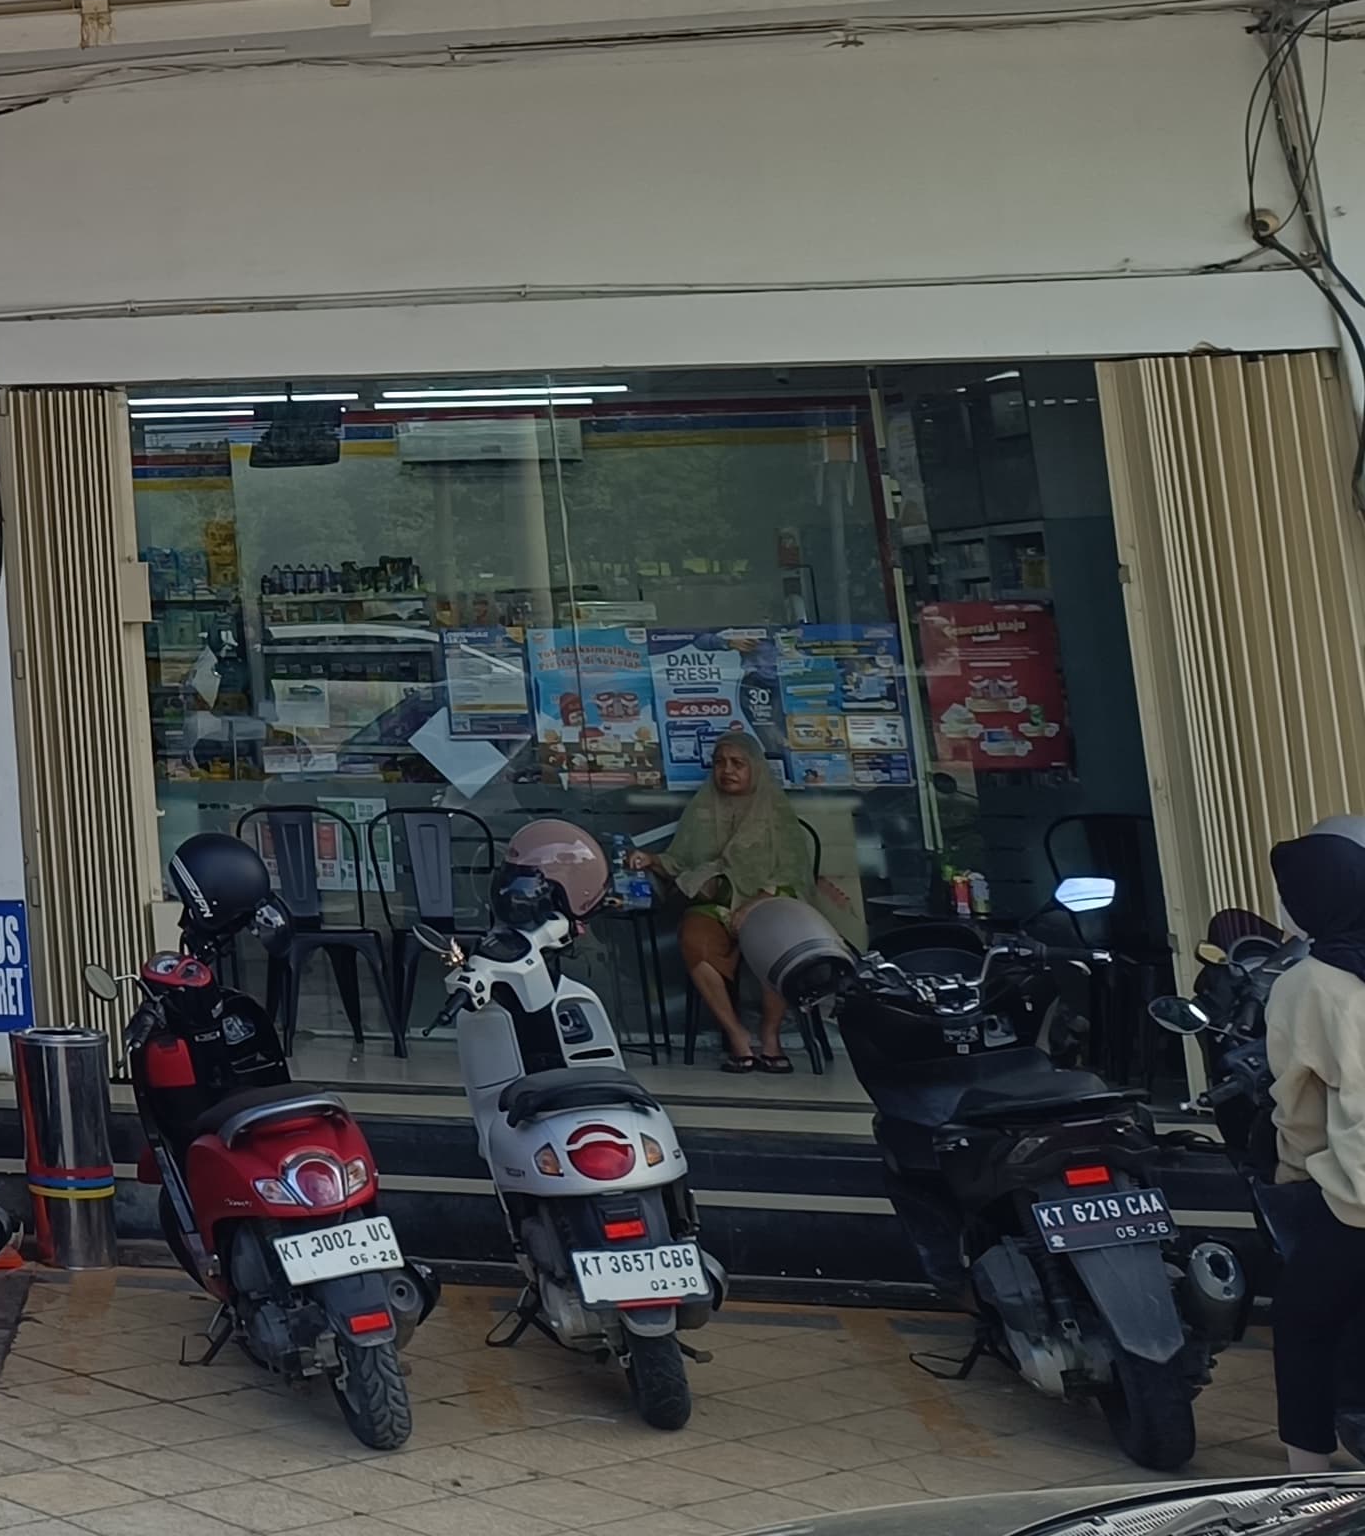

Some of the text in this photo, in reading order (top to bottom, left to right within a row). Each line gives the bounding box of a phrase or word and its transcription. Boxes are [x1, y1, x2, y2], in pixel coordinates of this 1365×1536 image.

[665, 667, 721, 681] FRESH
[666, 653, 717, 667] DAILY
[1038, 1192, 1165, 1228] KT 6219 CAA
[278, 1222, 392, 1262] KT 3002 UC
[579, 1248, 695, 1278] KT 3657 CBG
